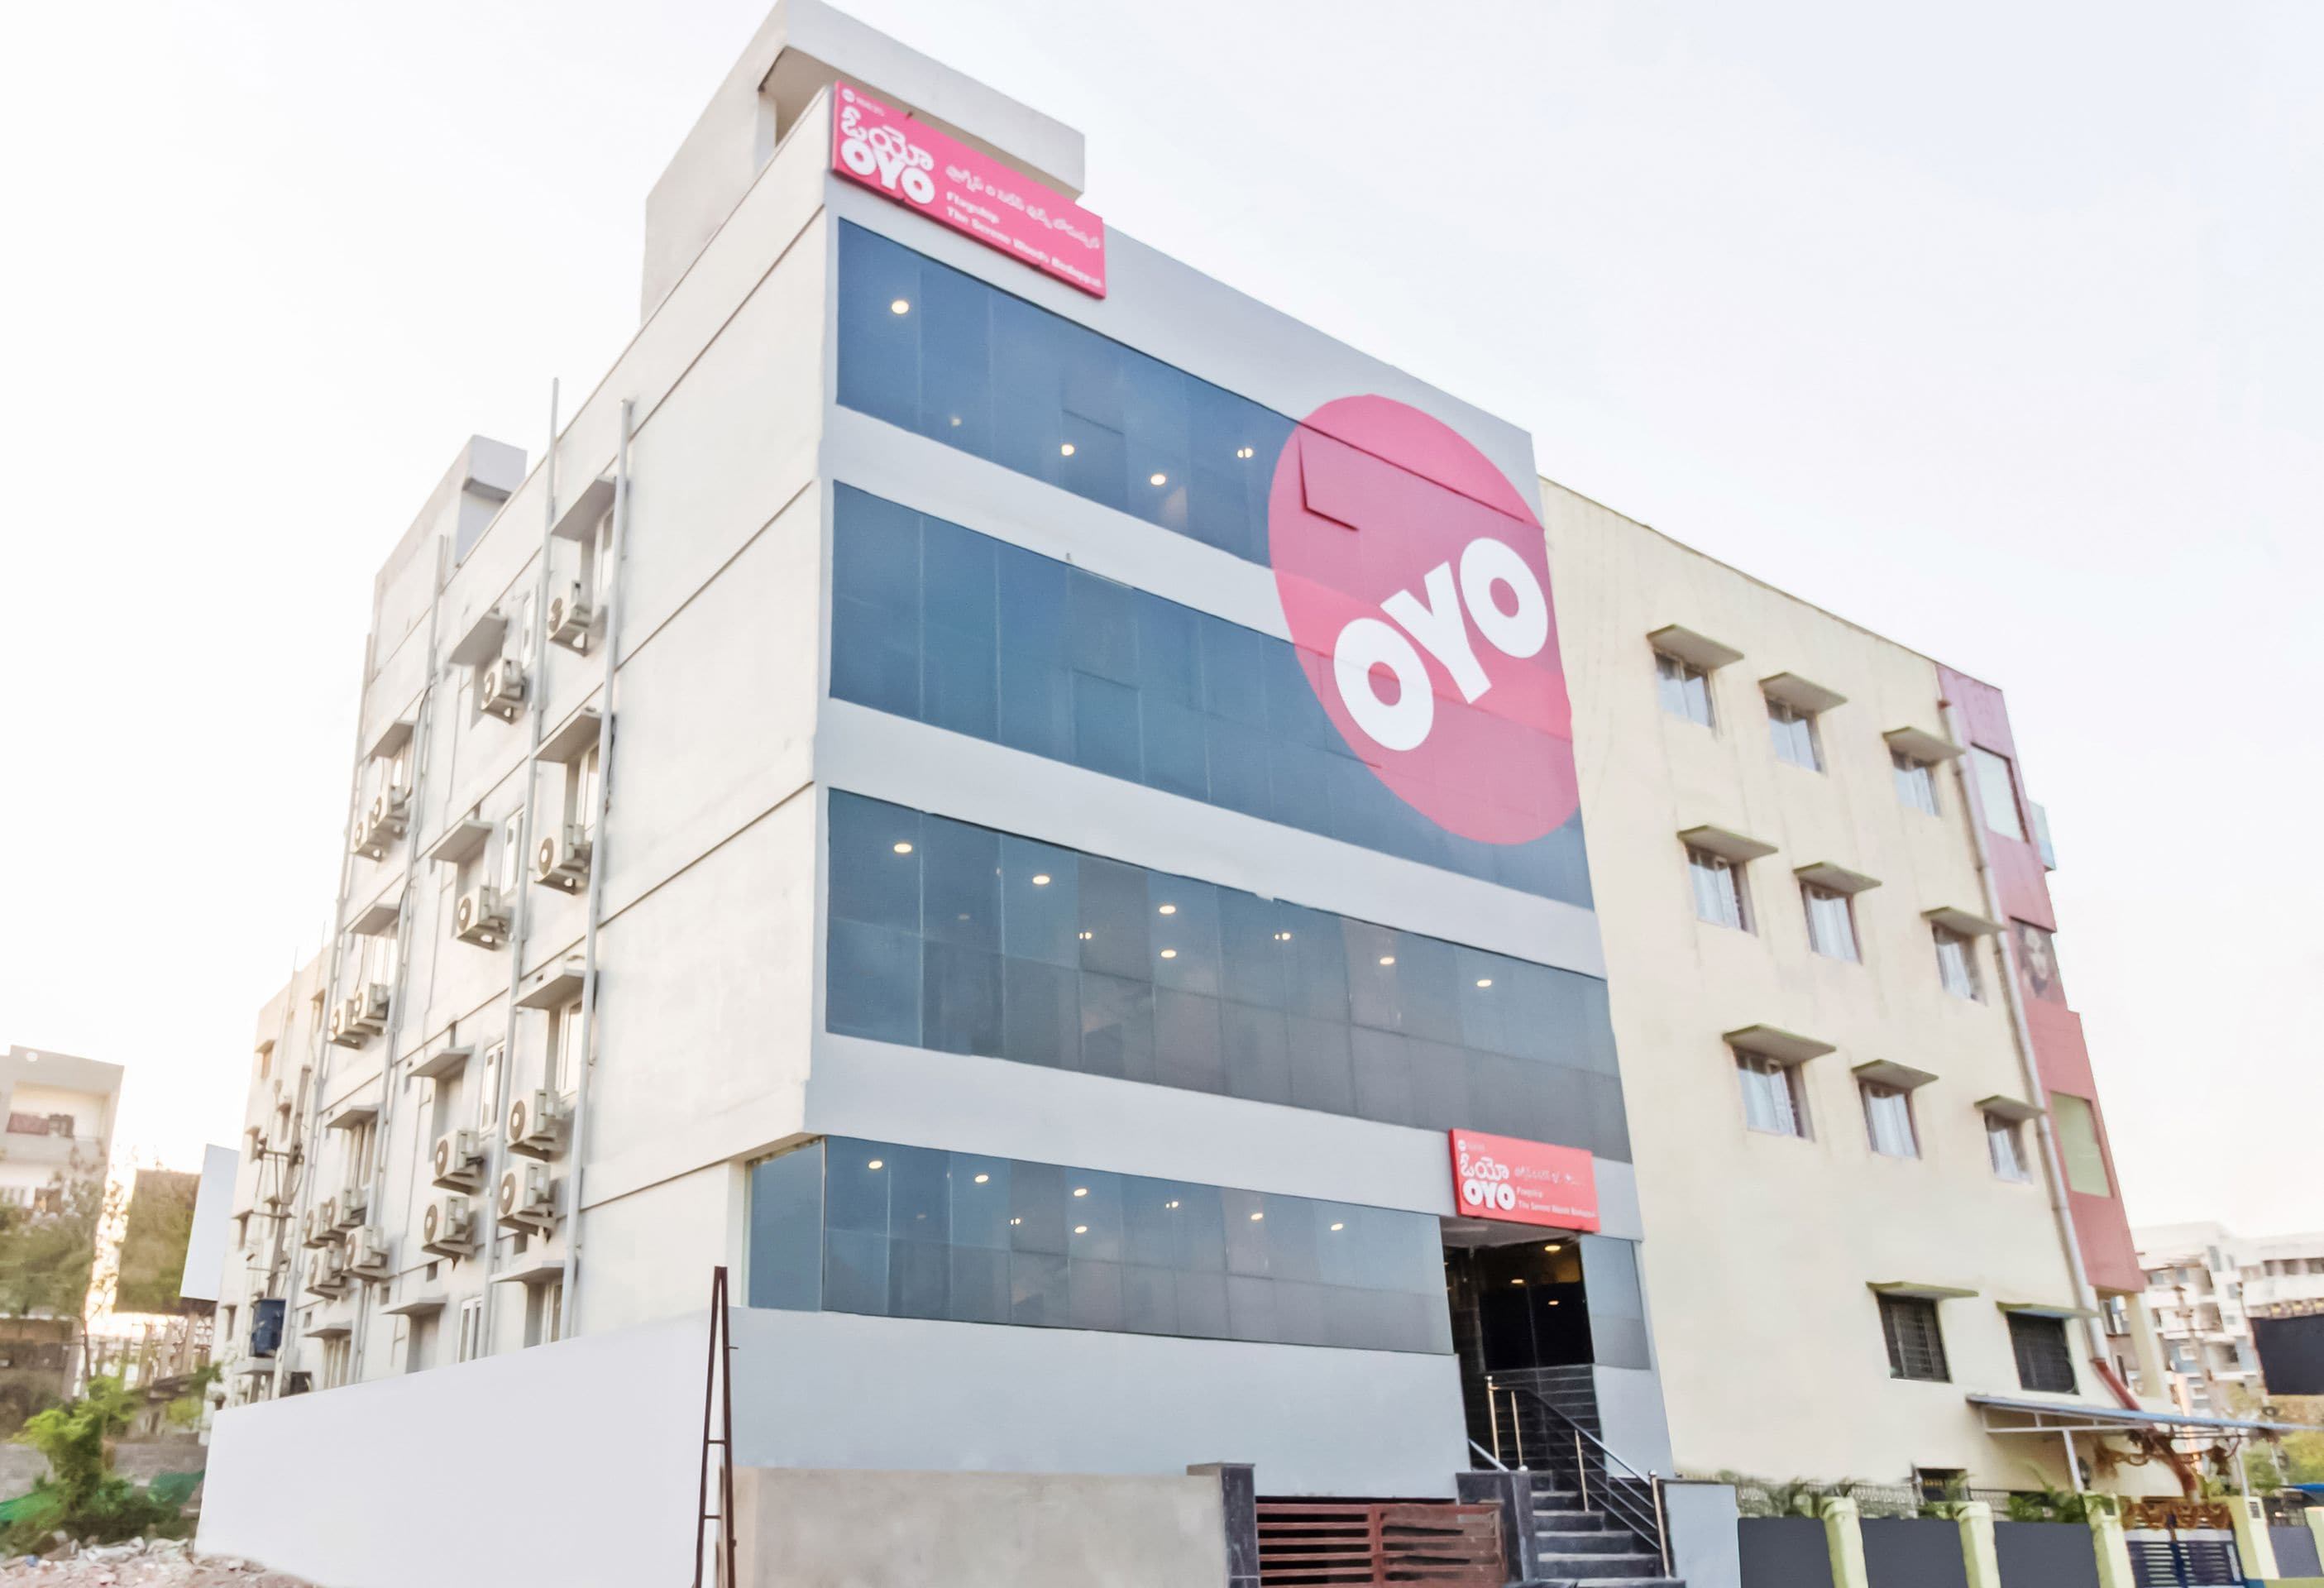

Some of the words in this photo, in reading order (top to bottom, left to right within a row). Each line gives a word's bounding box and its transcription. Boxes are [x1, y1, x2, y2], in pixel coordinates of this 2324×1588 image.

[841, 138, 935, 204] OYO
[1333, 537, 1549, 752] OYO
[1462, 1179, 1516, 1211] OYO
